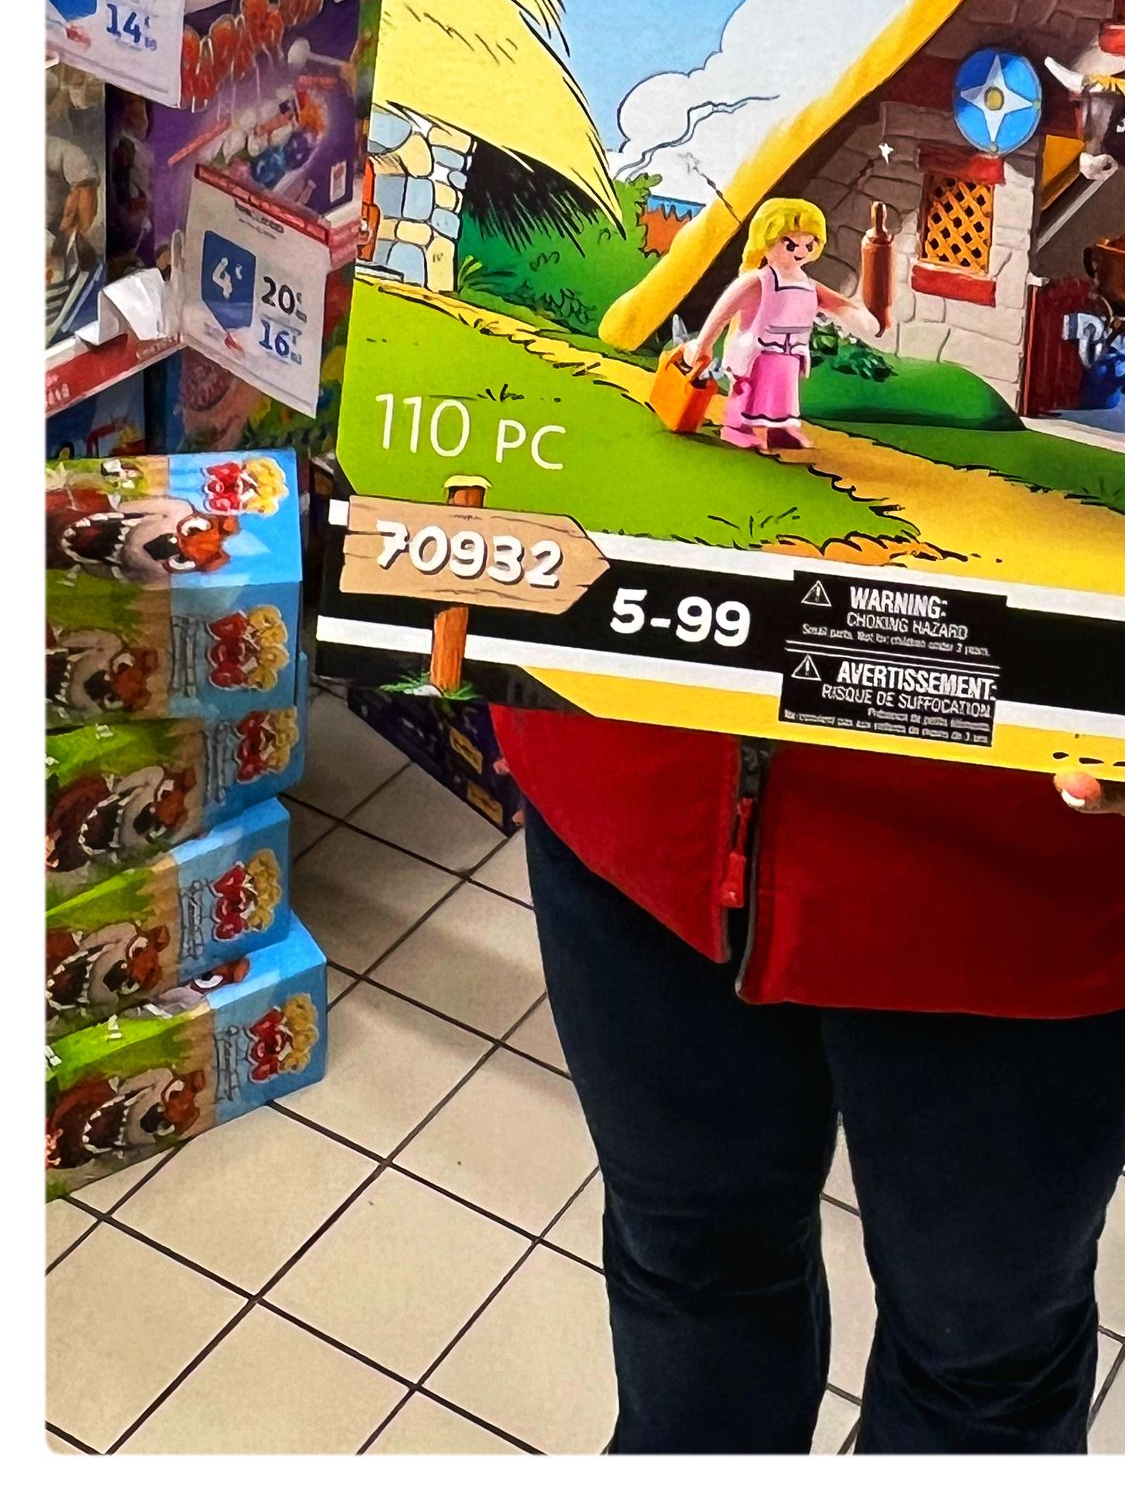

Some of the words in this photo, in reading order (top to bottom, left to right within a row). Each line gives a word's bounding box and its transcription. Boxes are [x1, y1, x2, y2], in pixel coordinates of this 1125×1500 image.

[376, 393, 471, 457] 110
[495, 419, 567, 470] PC
[375, 518, 564, 588] 70932
[610, 587, 751, 648] 5-99
[850, 586, 948, 619] WARNING:
[847, 612, 909, 633] CHOKING
[912, 620, 969, 641] HAZARD
[821, 683, 873, 706] RISQUE
[876, 690, 895, 707] DE
[837, 660, 998, 701] AVERTISSEMENT:
